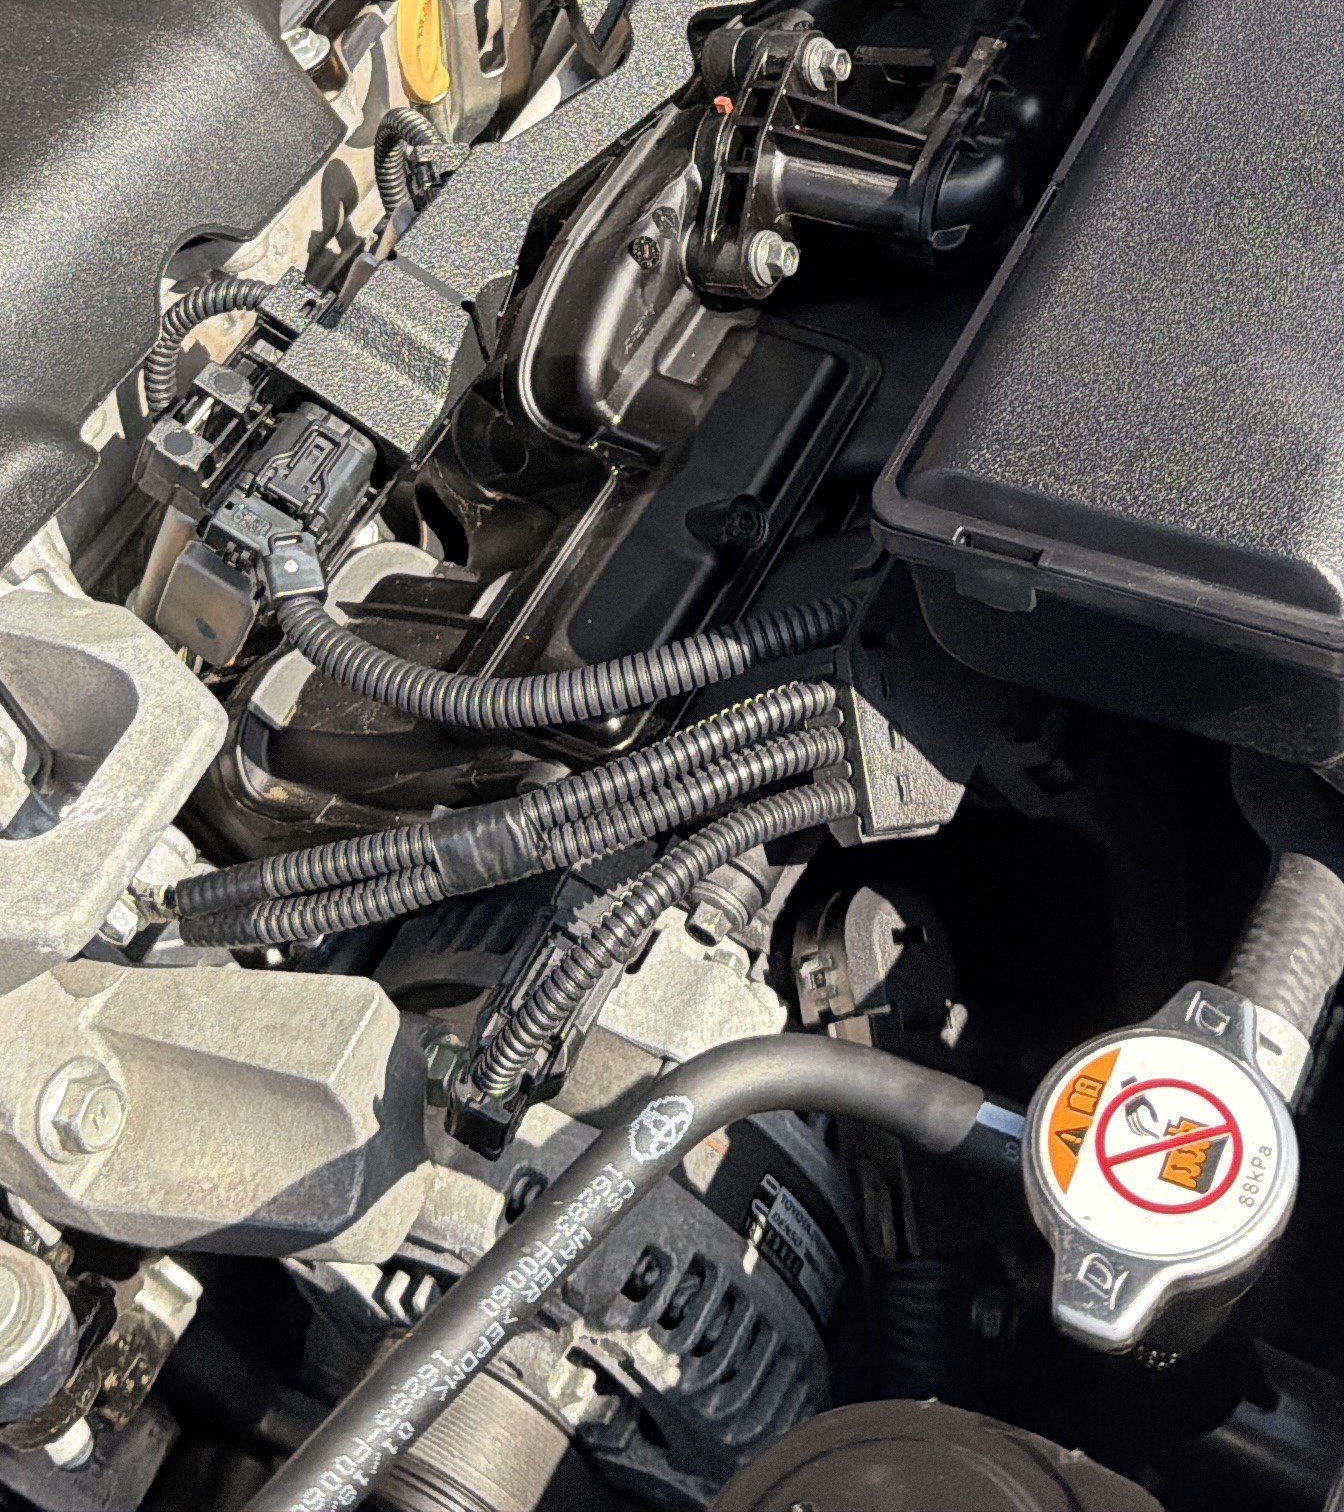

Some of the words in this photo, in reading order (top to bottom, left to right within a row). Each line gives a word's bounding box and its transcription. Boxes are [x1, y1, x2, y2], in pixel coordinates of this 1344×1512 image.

[605, 1178, 636, 1214] CS
[1237, 1144, 1274, 1209] 88kPa
[478, 1162, 626, 1319] 16283-F0060
[521, 1223, 593, 1305] WATER
